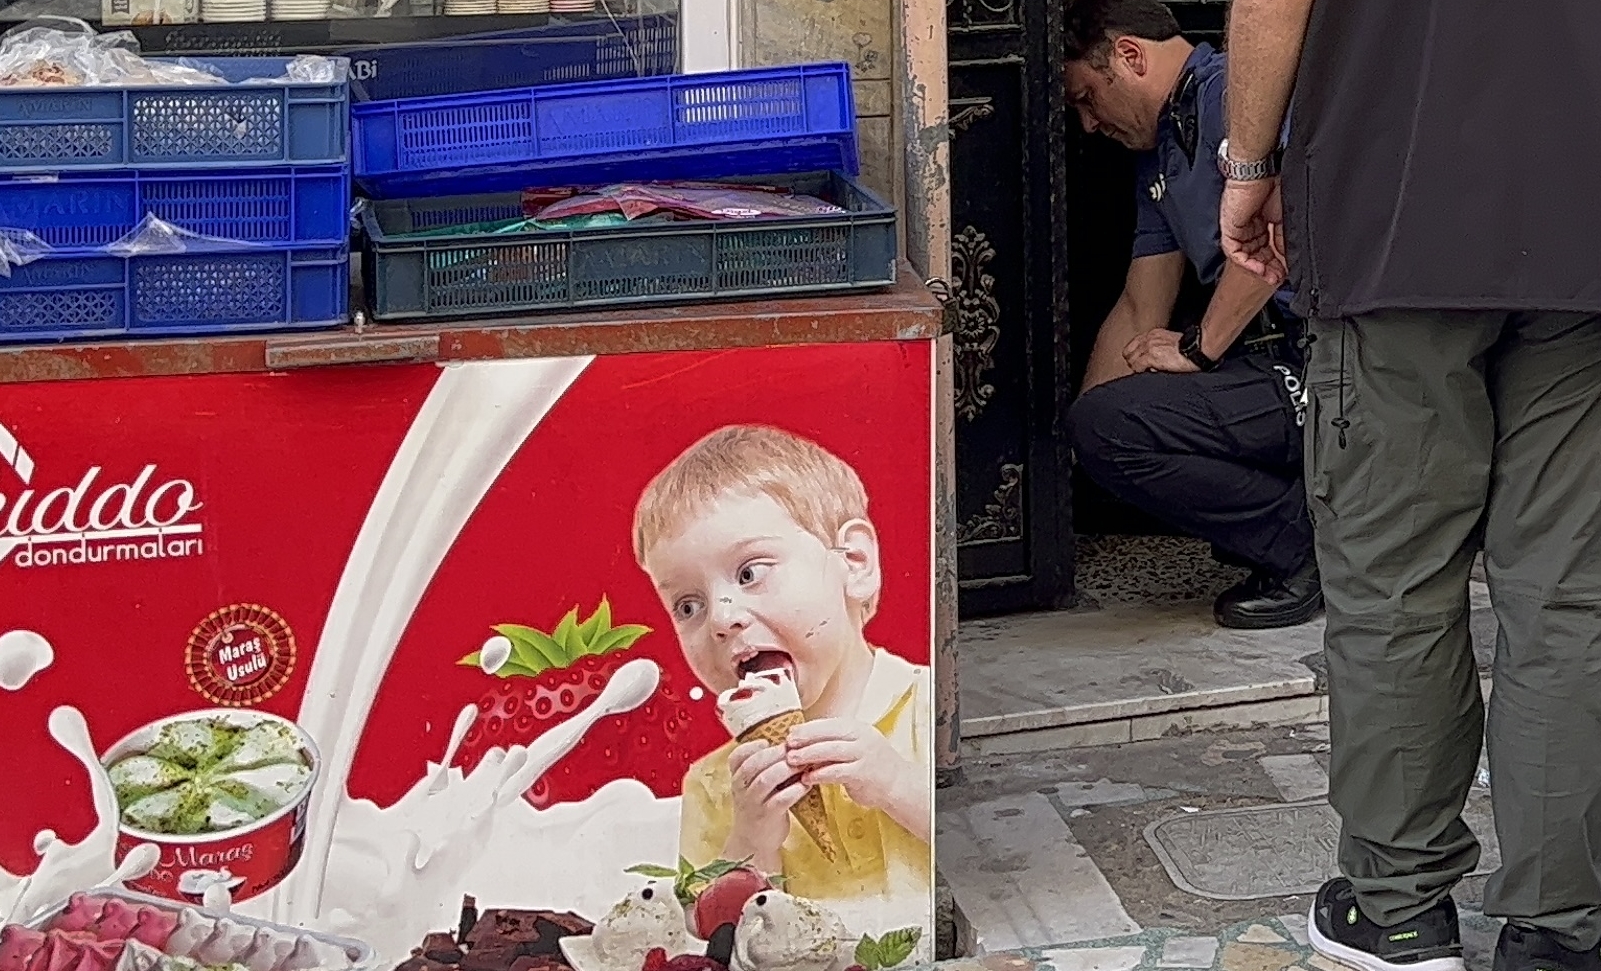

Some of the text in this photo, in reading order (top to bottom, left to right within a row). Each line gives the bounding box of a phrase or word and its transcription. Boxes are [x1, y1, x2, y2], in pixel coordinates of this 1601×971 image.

[0, 464, 204, 535] iddo
[14, 530, 204, 568] dondurmaları
[218, 636, 262, 665] Maraş
[226, 651, 267, 682] Usulü
